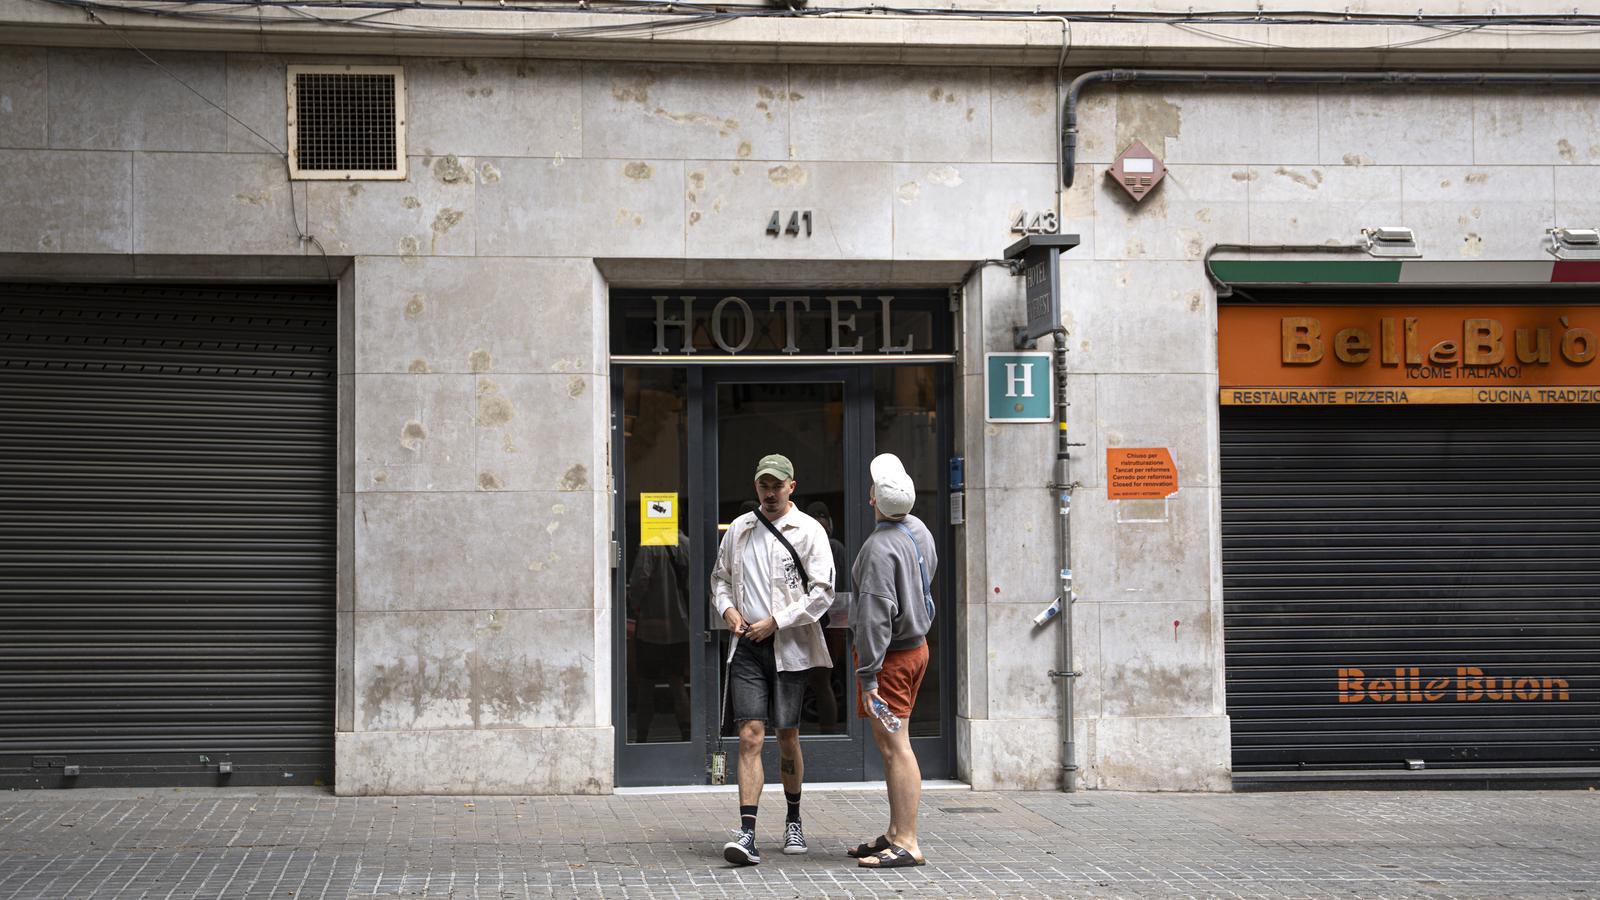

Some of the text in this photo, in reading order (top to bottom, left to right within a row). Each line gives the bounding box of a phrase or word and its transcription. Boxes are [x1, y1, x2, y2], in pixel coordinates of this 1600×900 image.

[766, 210, 812, 238] 441
[1011, 209, 1058, 236] 443
[1027, 261, 1047, 289] HOTEL
[651, 296, 914, 353] HOTEL
[1004, 363, 1035, 397] H
[1233, 391, 1409, 404] RESTAURANTE PIZZERIA
[1478, 390, 1532, 403] CUCINA
